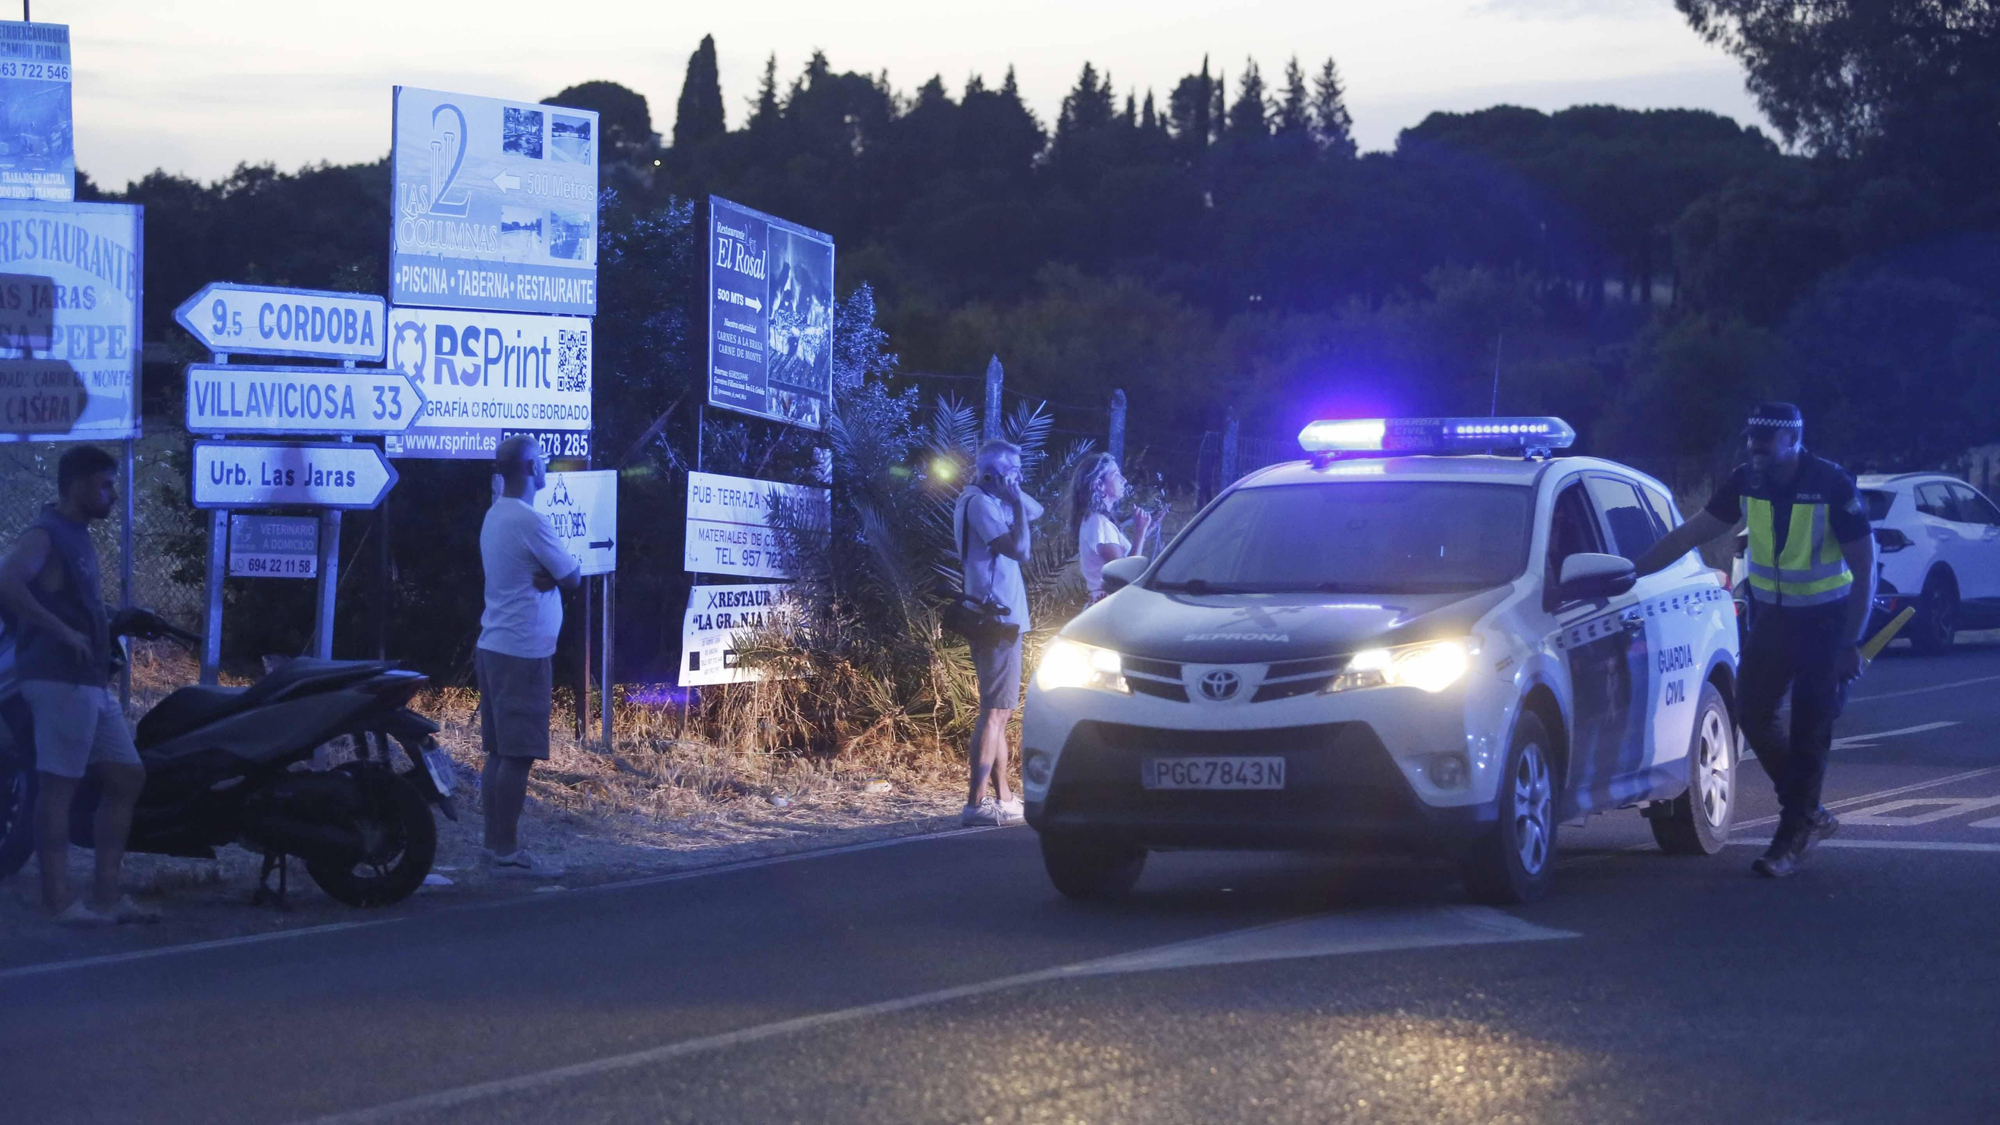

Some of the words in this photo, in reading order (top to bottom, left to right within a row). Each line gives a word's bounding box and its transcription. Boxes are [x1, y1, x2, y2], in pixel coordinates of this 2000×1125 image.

[21, 63, 43, 78] 722
[47, 65, 68, 80] 546
[401, 182, 428, 219] LAS
[429, 103, 472, 217] 2
[526, 171, 549, 196] 500
[552, 175, 594, 201] Metros
[400, 218, 498, 253] COLUMNAS
[716, 237, 732, 269] El
[734, 243, 766, 280] Rosal
[401, 266, 448, 294] PISCINA
[457, 269, 510, 299] TABERNA
[516, 275, 594, 304] RESTAURANTE
[717, 288, 730, 302] 500
[730, 291, 744, 306] MTS
[27, 284, 97, 317] JARAS
[259, 302, 375, 346] CORDOBA
[46, 325, 128, 360] PEPE
[736, 348, 745, 359] DE
[434, 324, 551, 389] RSPrint
[194, 380, 356, 420] VILLAVICIOSA
[372, 384, 403, 421] 33
[422, 397, 469, 418] GRAFÍA
[481, 398, 530, 419] RÓTULOS
[539, 403, 590, 420] BORDADO
[405, 432, 497, 454] www.rsprint.es
[564, 433, 588, 456] 285
[210, 460, 252, 486] Urb.
[260, 461, 295, 487] Las
[303, 463, 356, 487] Jaras
[260, 523, 315, 536] VETERINARIO
[698, 528, 748, 545] MATERIALES
[751, 533, 761, 546] DE
[263, 538, 270, 549] A
[271, 538, 314, 550] DOMICILIO
[248, 558, 267, 572] 694
[269, 559, 282, 572] 22
[285, 559, 296, 573] 11
[298, 560, 311, 573] 58
[715, 547, 737, 566] TEL.
[742, 549, 761, 567] 957
[765, 552, 783, 569] 723
[716, 611, 764, 630] GRNJA
[1182, 632, 1290, 642] SEPRONA
[1658, 643, 1694, 675] GUARDIA
[1665, 679, 1685, 706] CIVIL
